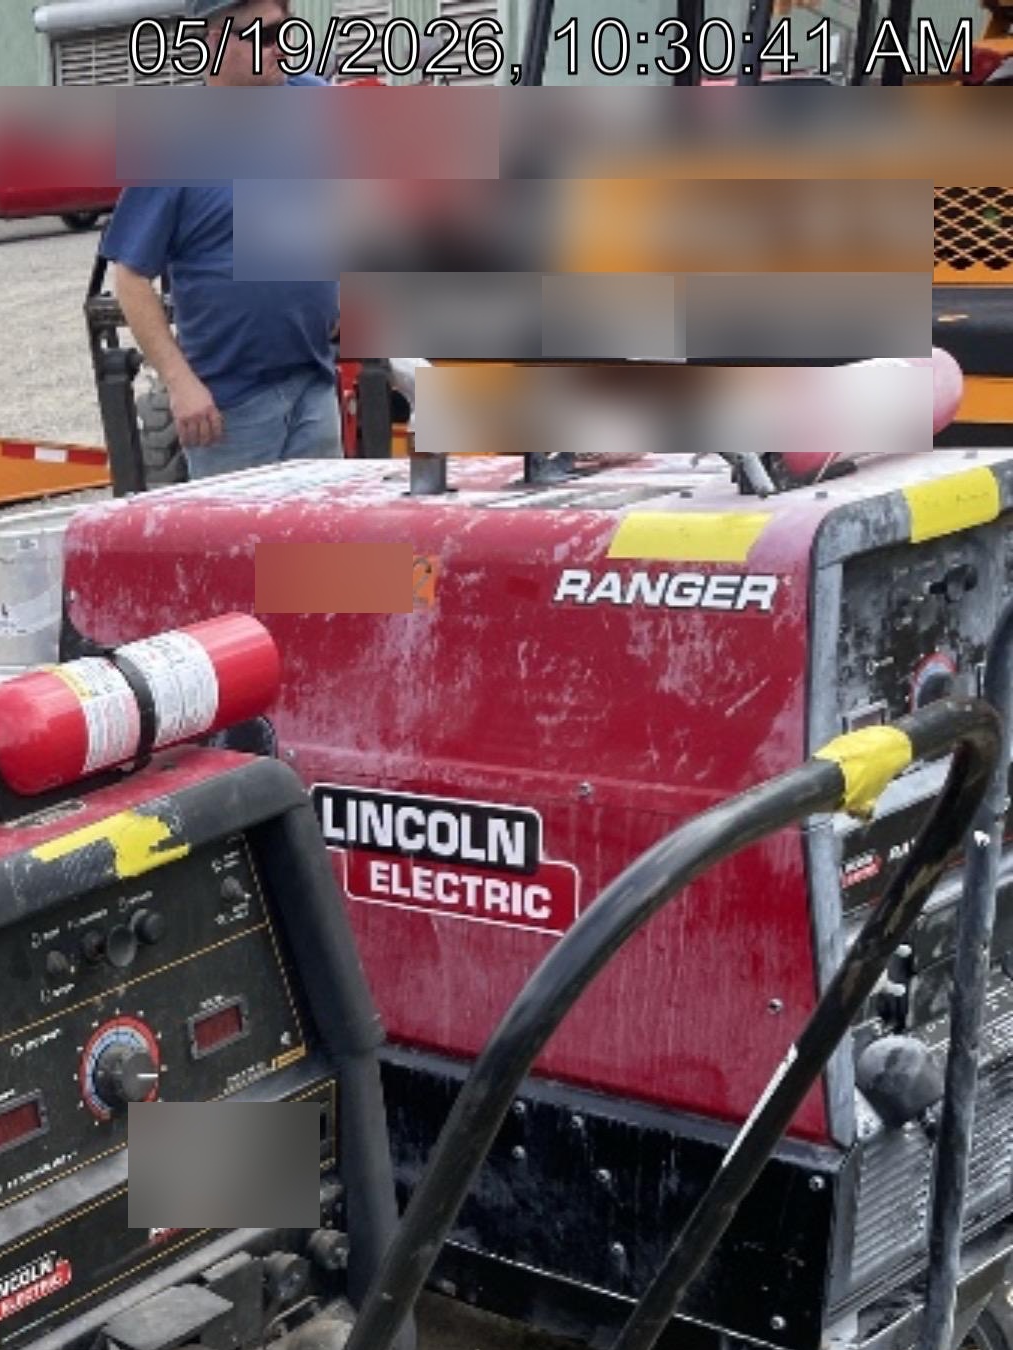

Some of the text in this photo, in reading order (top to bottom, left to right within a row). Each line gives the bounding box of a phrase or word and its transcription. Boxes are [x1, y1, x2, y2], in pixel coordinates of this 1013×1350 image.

[553, 569, 777, 611] RANGER
[322, 795, 525, 868] LINCOLN
[370, 860, 552, 920] ELECTRIC
